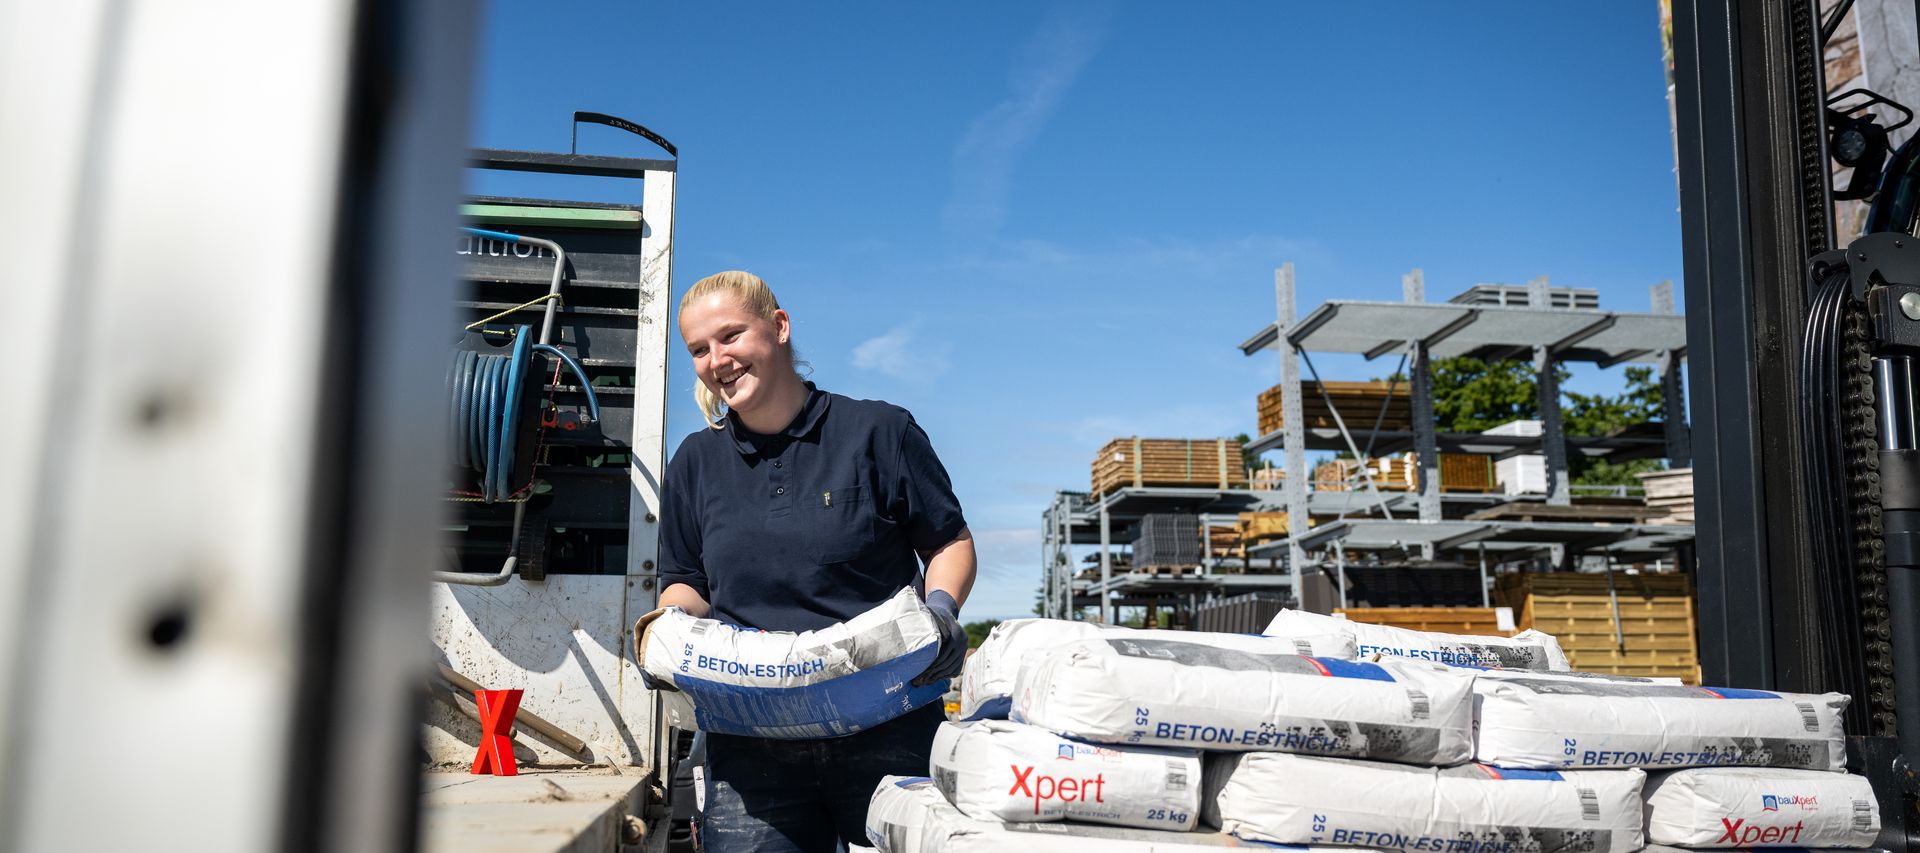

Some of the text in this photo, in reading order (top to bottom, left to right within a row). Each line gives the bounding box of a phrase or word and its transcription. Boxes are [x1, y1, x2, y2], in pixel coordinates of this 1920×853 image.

[680, 643, 694, 672] 25 kg
[698, 655, 825, 678] BETON-ESTRICH
[1135, 707, 1149, 726] 25
[1155, 722, 1338, 751] BETON-ESTRICH
[1564, 738, 1576, 755] 25
[1009, 764, 1105, 815] Xpert
[1777, 795, 1818, 810] bauXpert
[1147, 809, 1188, 823] 25 kg
[1312, 814, 1326, 832] 25
[1716, 817, 1804, 848] Xpert
